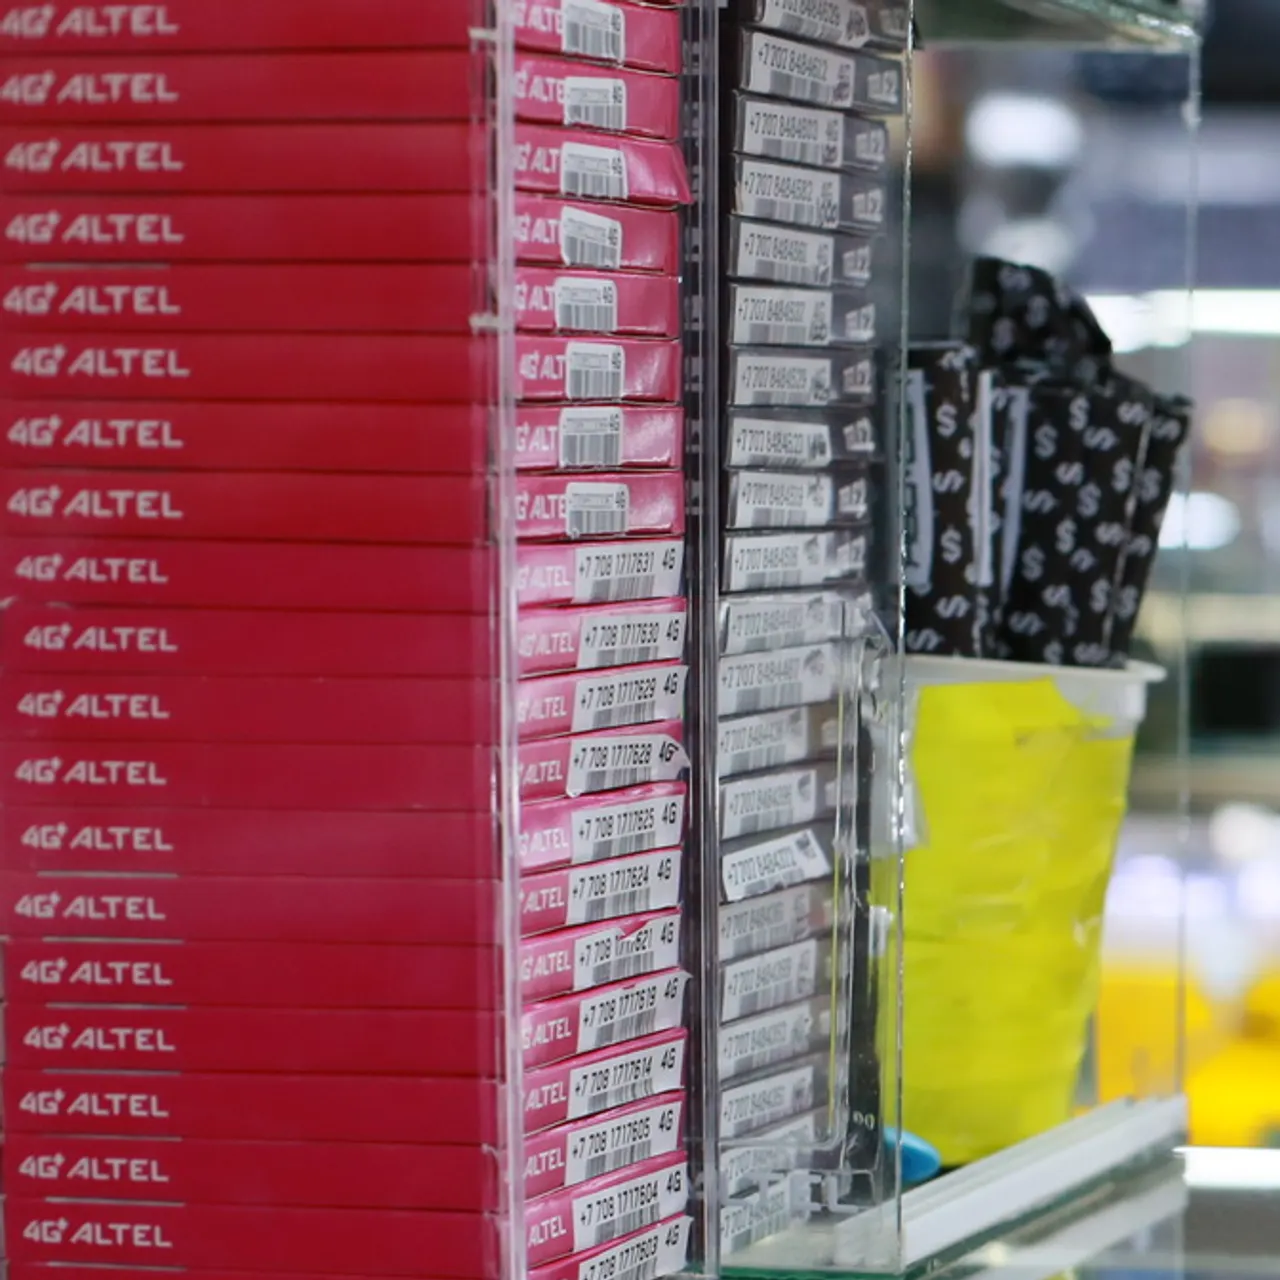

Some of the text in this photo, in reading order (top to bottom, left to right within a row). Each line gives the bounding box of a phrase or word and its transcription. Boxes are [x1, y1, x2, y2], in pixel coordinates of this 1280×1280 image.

[59, 6, 176, 33] ALTEL
[59, 74, 176, 100] ALTEL
[64, 143, 181, 169] ALTEL
[64, 215, 182, 241] ALTEL
[61, 287, 178, 312] ALTEL
[70, 349, 188, 375] ALTEL
[64, 420, 182, 446] ALTEL
[64, 491, 181, 517] ALTEL
[65, 559, 166, 581] ALTEL
[580, 556, 591, 578] +7
[594, 555, 612, 576] 708
[662, 548, 675, 569] 4G
[529, 566, 571, 589] ALTEL
[75, 628, 176, 650] ALTEL
[535, 632, 574, 655] ALTEL
[585, 627, 597, 647] +7
[600, 625, 617, 647] 708
[666, 619, 679, 641] 4G
[581, 688, 594, 708] +7
[596, 685, 614, 707] 708
[663, 673, 678, 696] 4G
[67, 695, 168, 718] ALTEL
[529, 695, 566, 720] ALTEL
[574, 748, 586, 768] +7
[589, 746, 607, 768] 708
[659, 741, 678, 763] 4G
[65, 762, 165, 784] ALTEL
[523, 760, 563, 785] ALTEL
[579, 819, 591, 840] +7
[595, 815, 613, 838] 708
[662, 802, 677, 824] 4G
[71, 827, 172, 850] ALTEL
[529, 828, 568, 852] ALTEL
[573, 878, 585, 899] +7
[589, 874, 606, 897] 708
[657, 858, 671, 881] 4G
[64, 897, 165, 919] ALTEL
[523, 886, 564, 913] ALTEL
[580, 945, 591, 966] +7
[594, 937, 611, 962] 708
[660, 922, 674, 944] 4G
[71, 962, 171, 984] ALTEL
[533, 950, 571, 979] ALTEL
[584, 1005, 595, 1027] +7
[598, 1000, 616, 1022] 708
[664, 978, 678, 999] 4G
[73, 1027, 175, 1050] ALTEL
[533, 1017, 571, 1045] ALTEL
[576, 1075, 587, 1096] +7
[591, 1069, 609, 1095] 708
[661, 1048, 675, 1071] 4G
[68, 1094, 168, 1116] ALTEL
[526, 1082, 566, 1111] ALTEL
[573, 1137, 585, 1158] +7
[589, 1132, 606, 1156] 708
[659, 1110, 673, 1132] 4G
[68, 1158, 168, 1181] ALTEL
[522, 1148, 565, 1177] ALTEL
[581, 1203, 593, 1225] +7
[596, 1197, 614, 1223] 708
[666, 1171, 681, 1194] 4G
[71, 1222, 172, 1246] ALTEL
[528, 1215, 566, 1248] ALTEL
[665, 1225, 679, 1247] 4G
